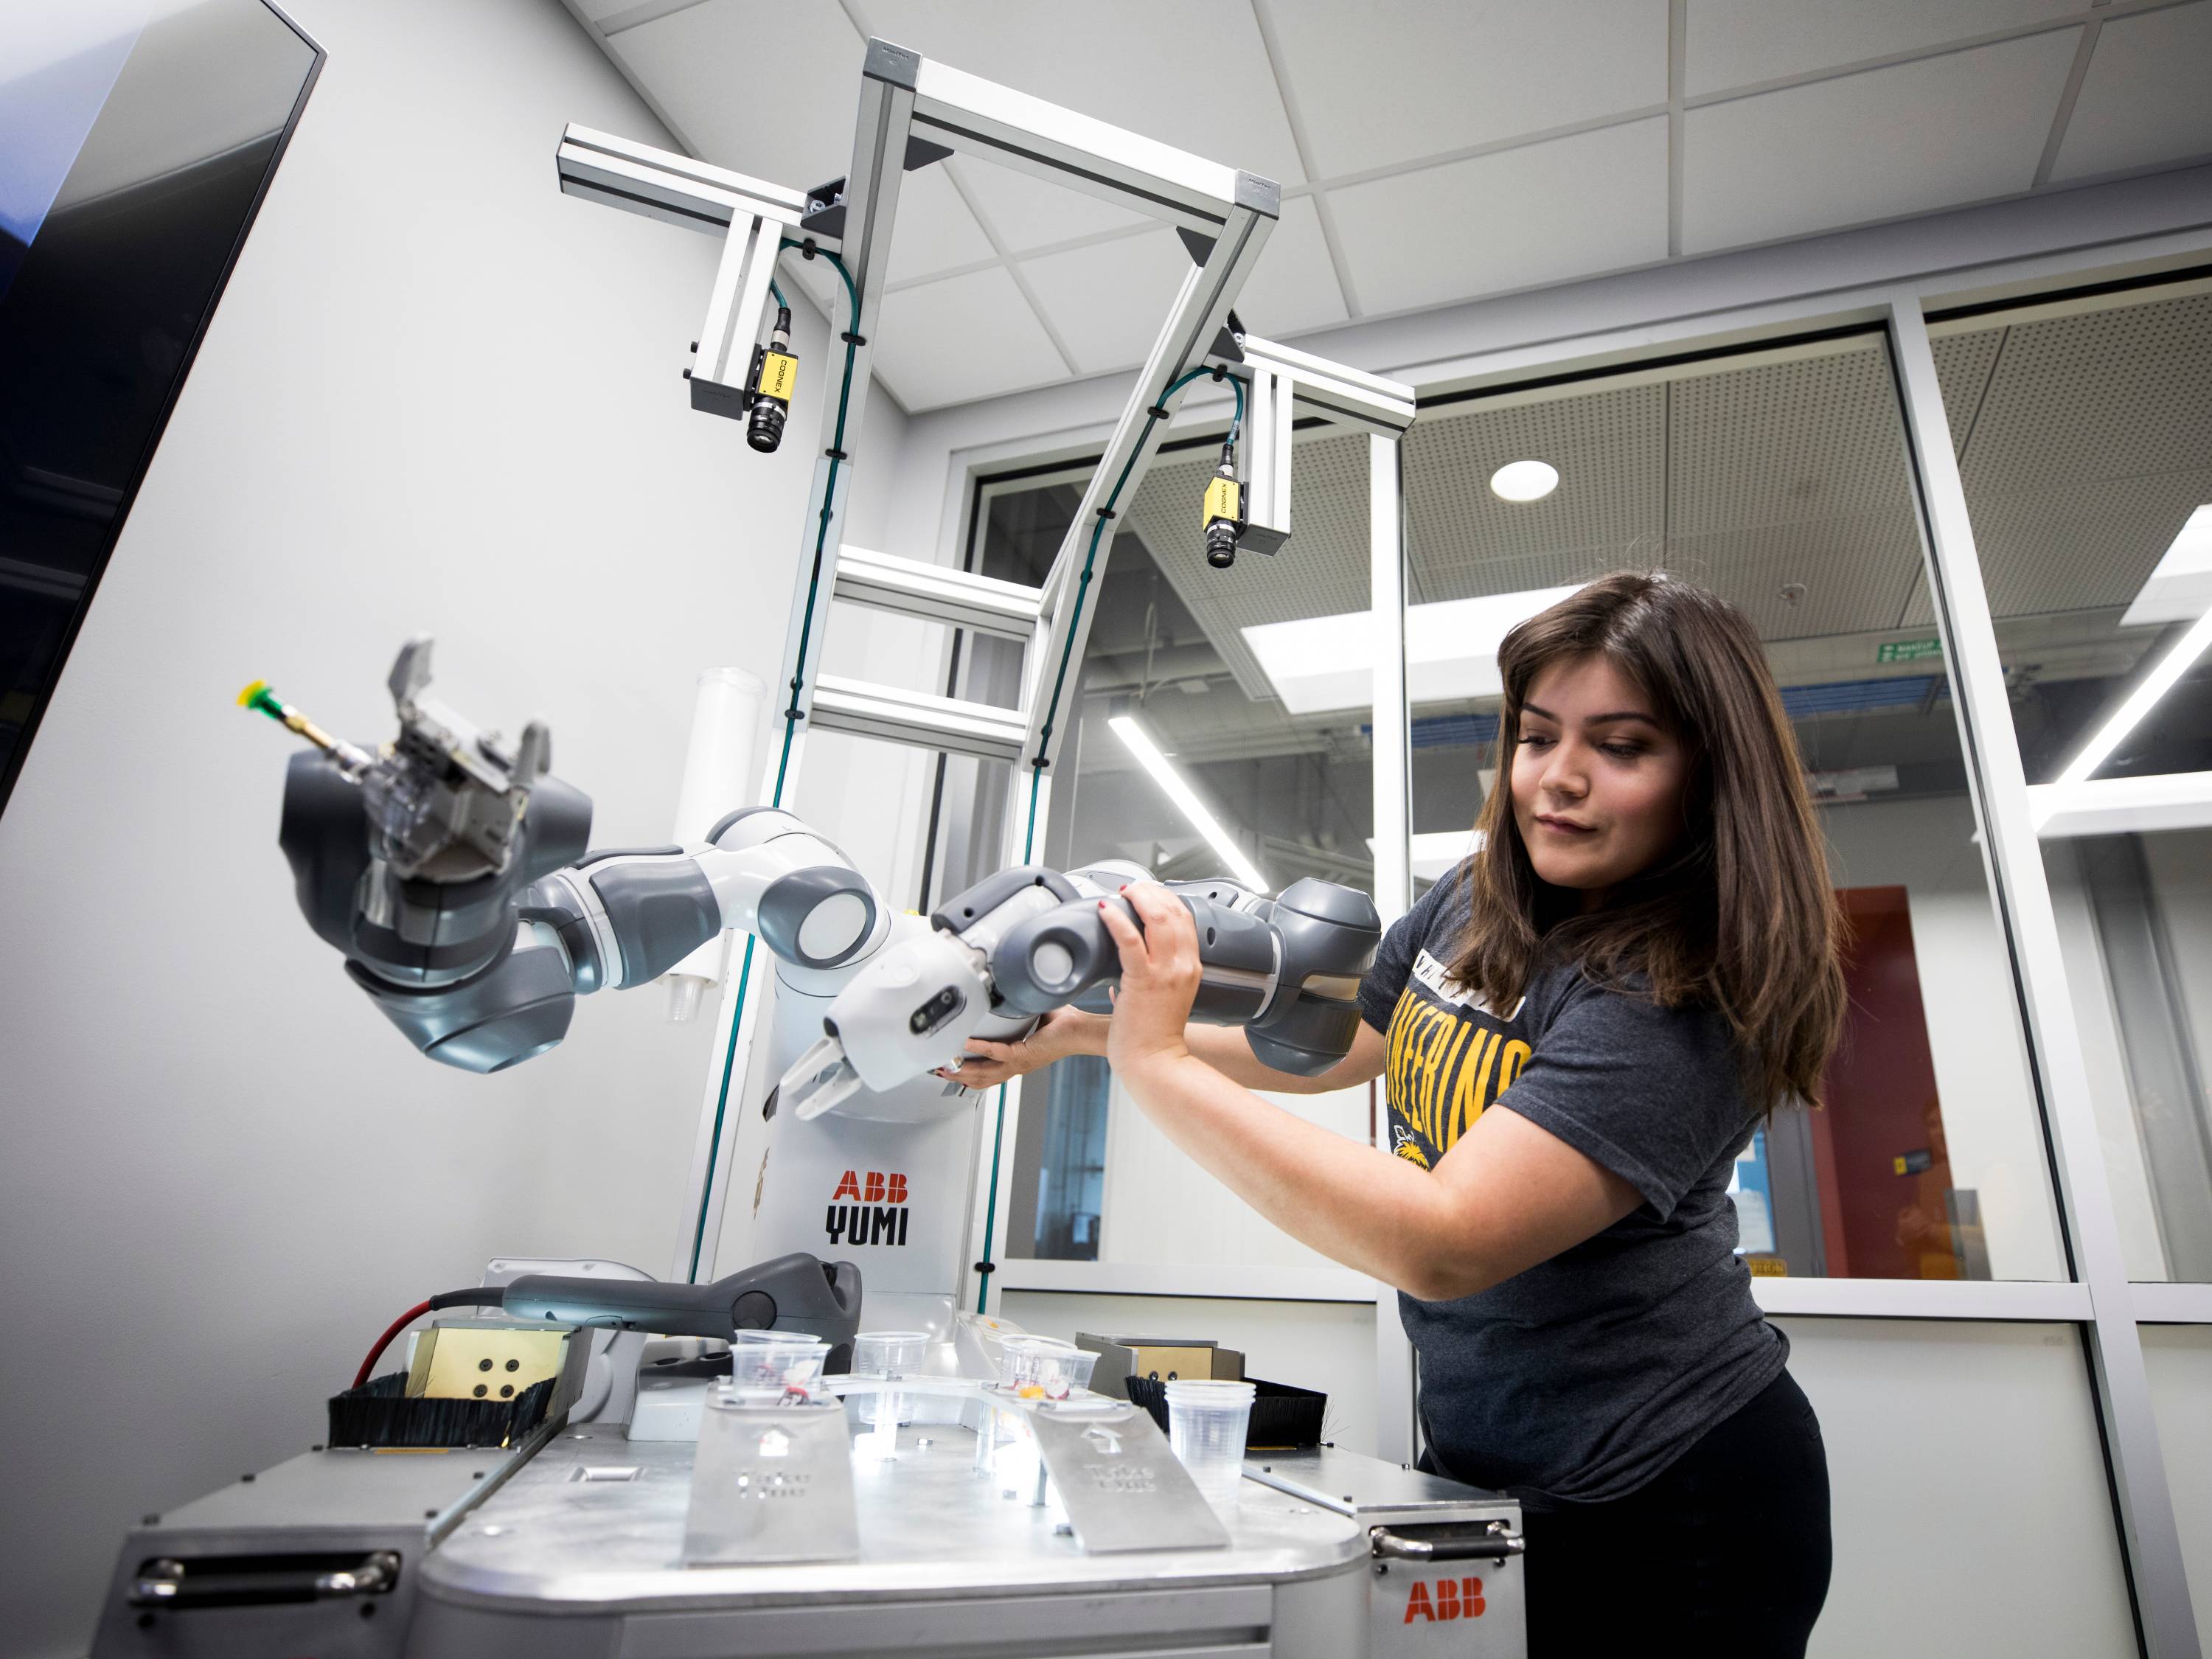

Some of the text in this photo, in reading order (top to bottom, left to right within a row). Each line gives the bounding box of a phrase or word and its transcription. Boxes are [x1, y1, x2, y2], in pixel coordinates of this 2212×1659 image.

[774, 359, 787, 394] COGNEX
[832, 1170, 908, 1203] ABB
[826, 1206, 908, 1246] YUMI
[1404, 1576, 1486, 1624] ABB
